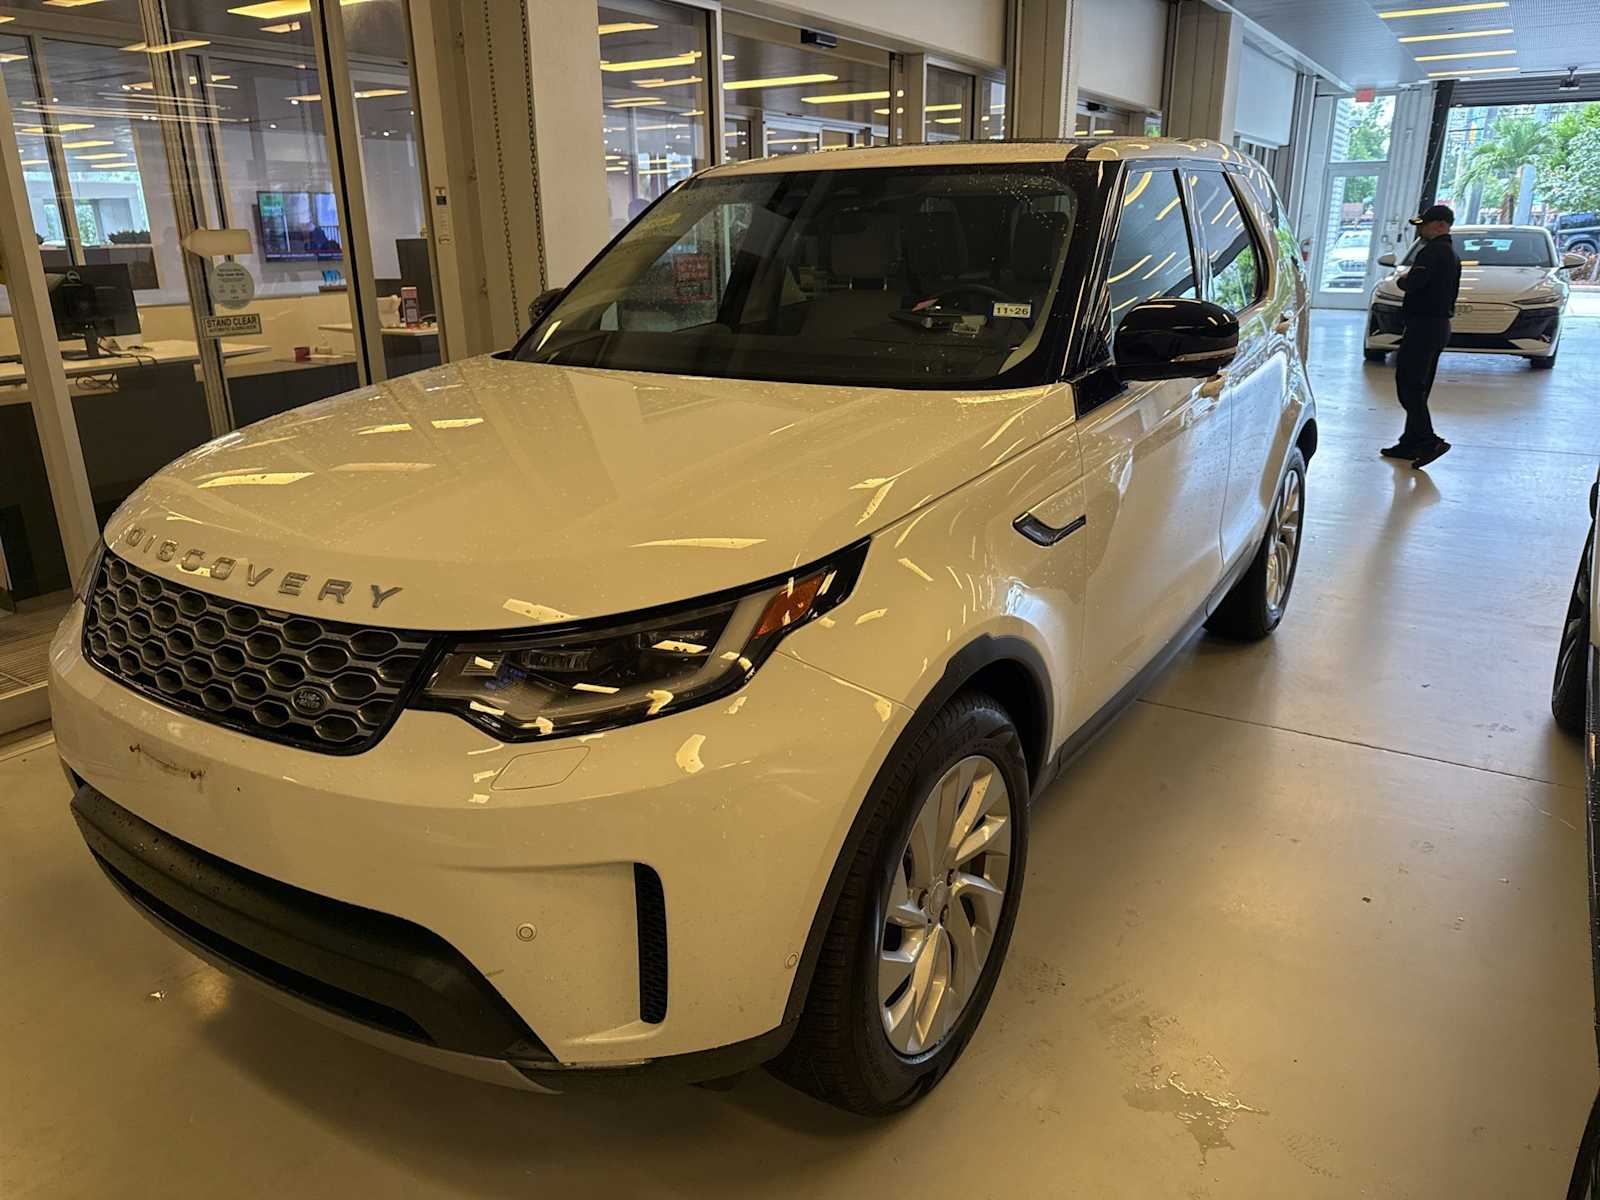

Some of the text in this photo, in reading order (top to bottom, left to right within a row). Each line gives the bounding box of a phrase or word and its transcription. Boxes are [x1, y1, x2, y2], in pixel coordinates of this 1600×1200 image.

[207, 316, 256, 328] STAND CLEAR
[125, 527, 403, 608] DISCOVERY
